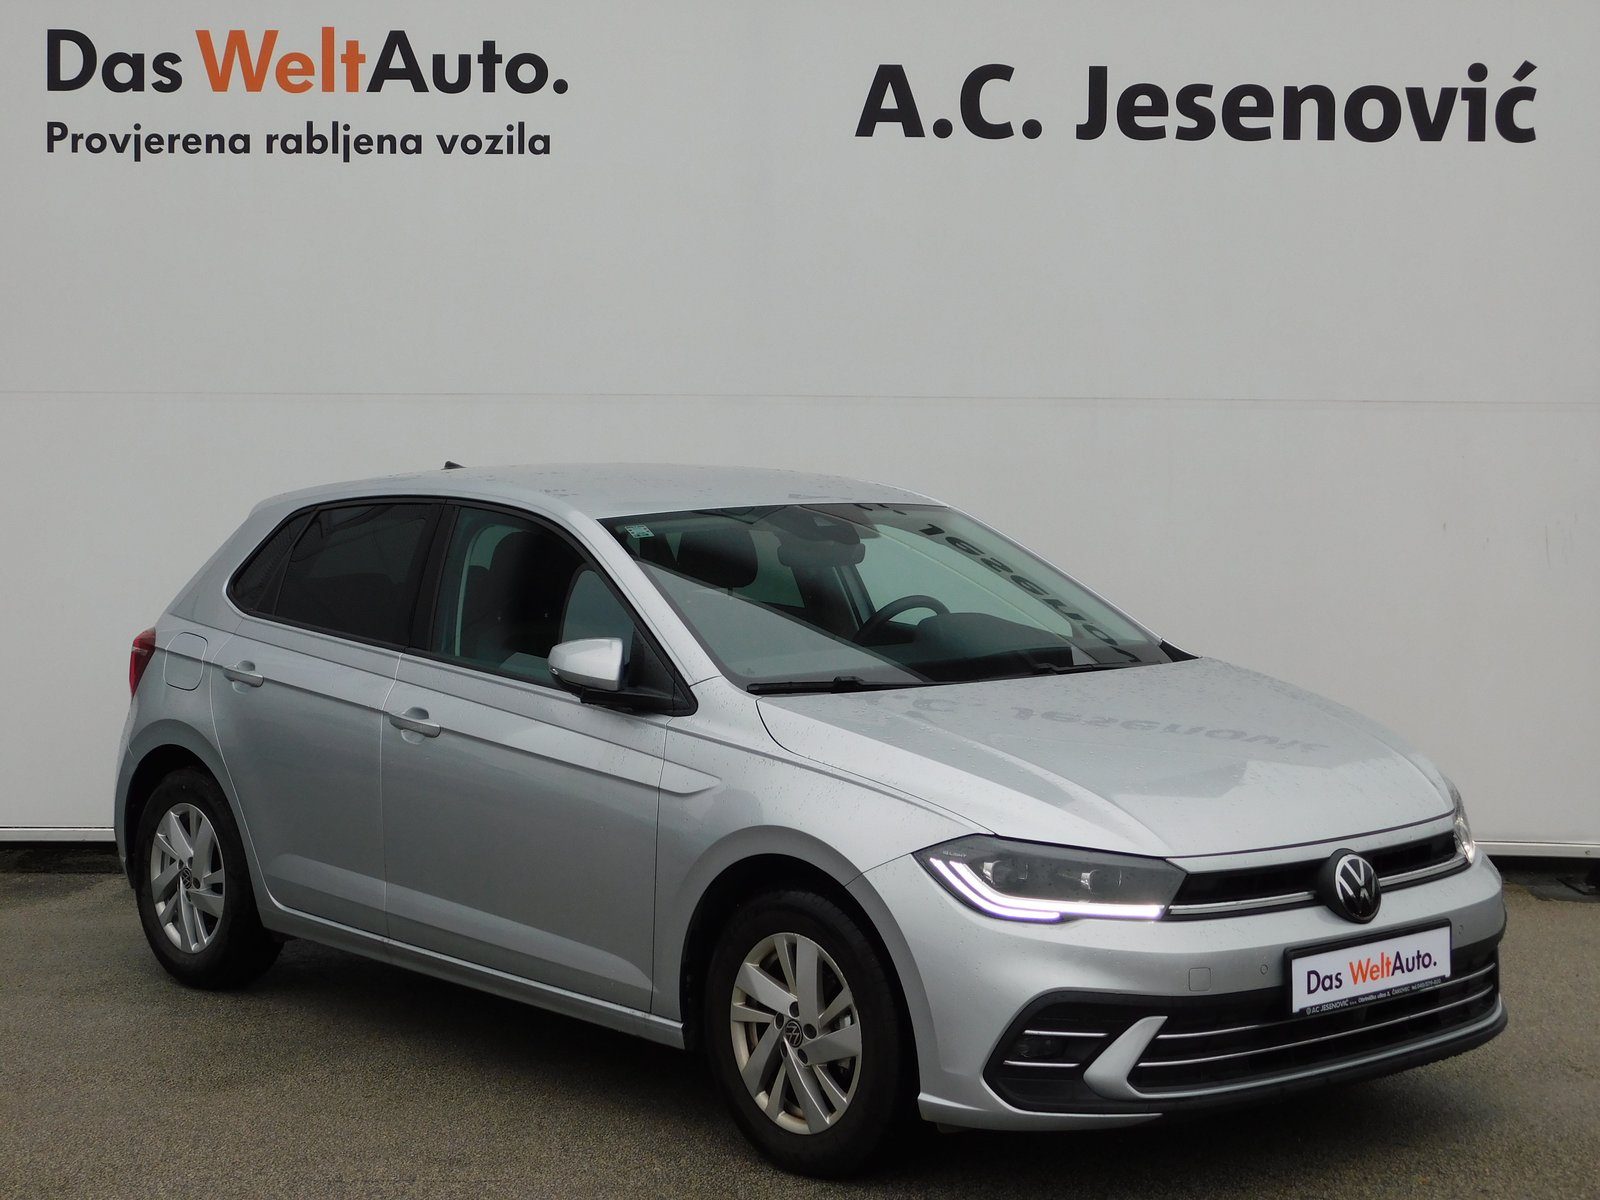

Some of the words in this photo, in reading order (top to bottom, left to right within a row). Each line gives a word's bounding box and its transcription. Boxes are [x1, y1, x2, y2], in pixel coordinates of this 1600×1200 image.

[46, 28, 183, 94] Das
[195, 26, 569, 95] WeltAuto.
[854, 63, 1043, 140] A.C.
[1075, 59, 1538, 144] Jesenović
[46, 121, 251, 163] Provjerena
[266, 120, 423, 163] rabljena
[435, 121, 551, 156] vozila
[1306, 969, 1343, 995] Das
[1349, 950, 1437, 985] WeltAuto.
